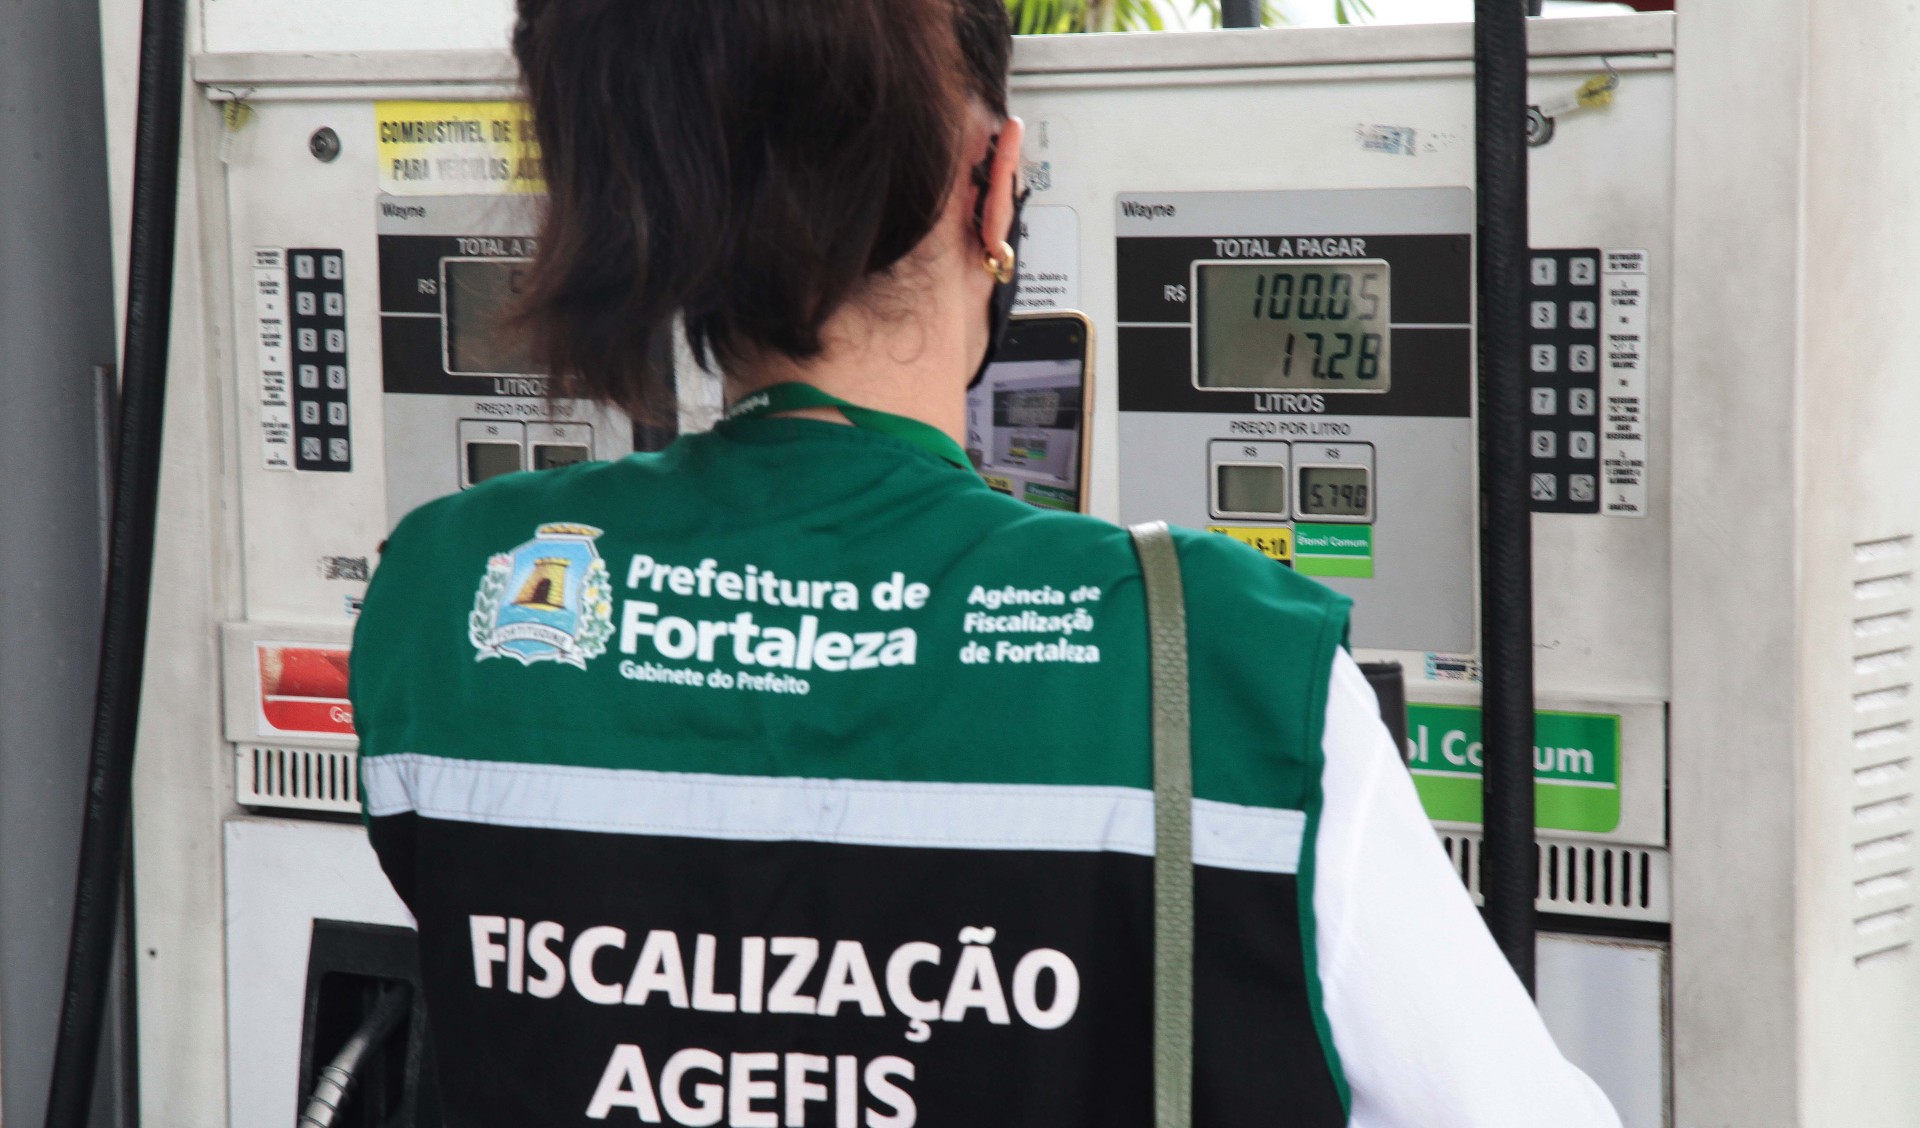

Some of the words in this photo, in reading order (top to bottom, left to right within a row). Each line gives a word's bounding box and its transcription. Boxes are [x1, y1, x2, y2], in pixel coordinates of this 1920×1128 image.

[381, 116, 486, 143] COMBUSTÍVEL
[491, 120, 512, 143] DE
[393, 157, 431, 181] PARA
[381, 202, 427, 220] Wayne
[1120, 201, 1176, 220] Wayne
[456, 237, 508, 256] TOTAL
[510, 238, 524, 256] A
[1212, 238, 1276, 257] TOTAL
[1278, 238, 1294, 257] A
[1296, 238, 1367, 257] PAGAR
[1164, 284, 1187, 303] R$
[1254, 273, 1379, 321] 100.05
[475, 402, 513, 416] PREÇO
[516, 403, 539, 416] POR
[1254, 393, 1325, 413] LITROS
[1230, 420, 1276, 437] PREÇO
[1279, 421, 1308, 435] POR
[1311, 421, 1351, 436] LITRO
[1331, 535, 1369, 548] Comum
[626, 554, 859, 611] Prefeitura
[871, 571, 931, 611] de
[967, 584, 1066, 609] Agência
[1069, 585, 1102, 604] de
[619, 599, 918, 672] Fortaleza
[959, 640, 991, 664] de
[619, 659, 704, 688] Gabinete
[707, 668, 734, 689] do
[737, 670, 811, 695] Prefeito
[469, 914, 1081, 1043] FISCALIZAÇÃO
[585, 1043, 918, 1128] AGEFIS
